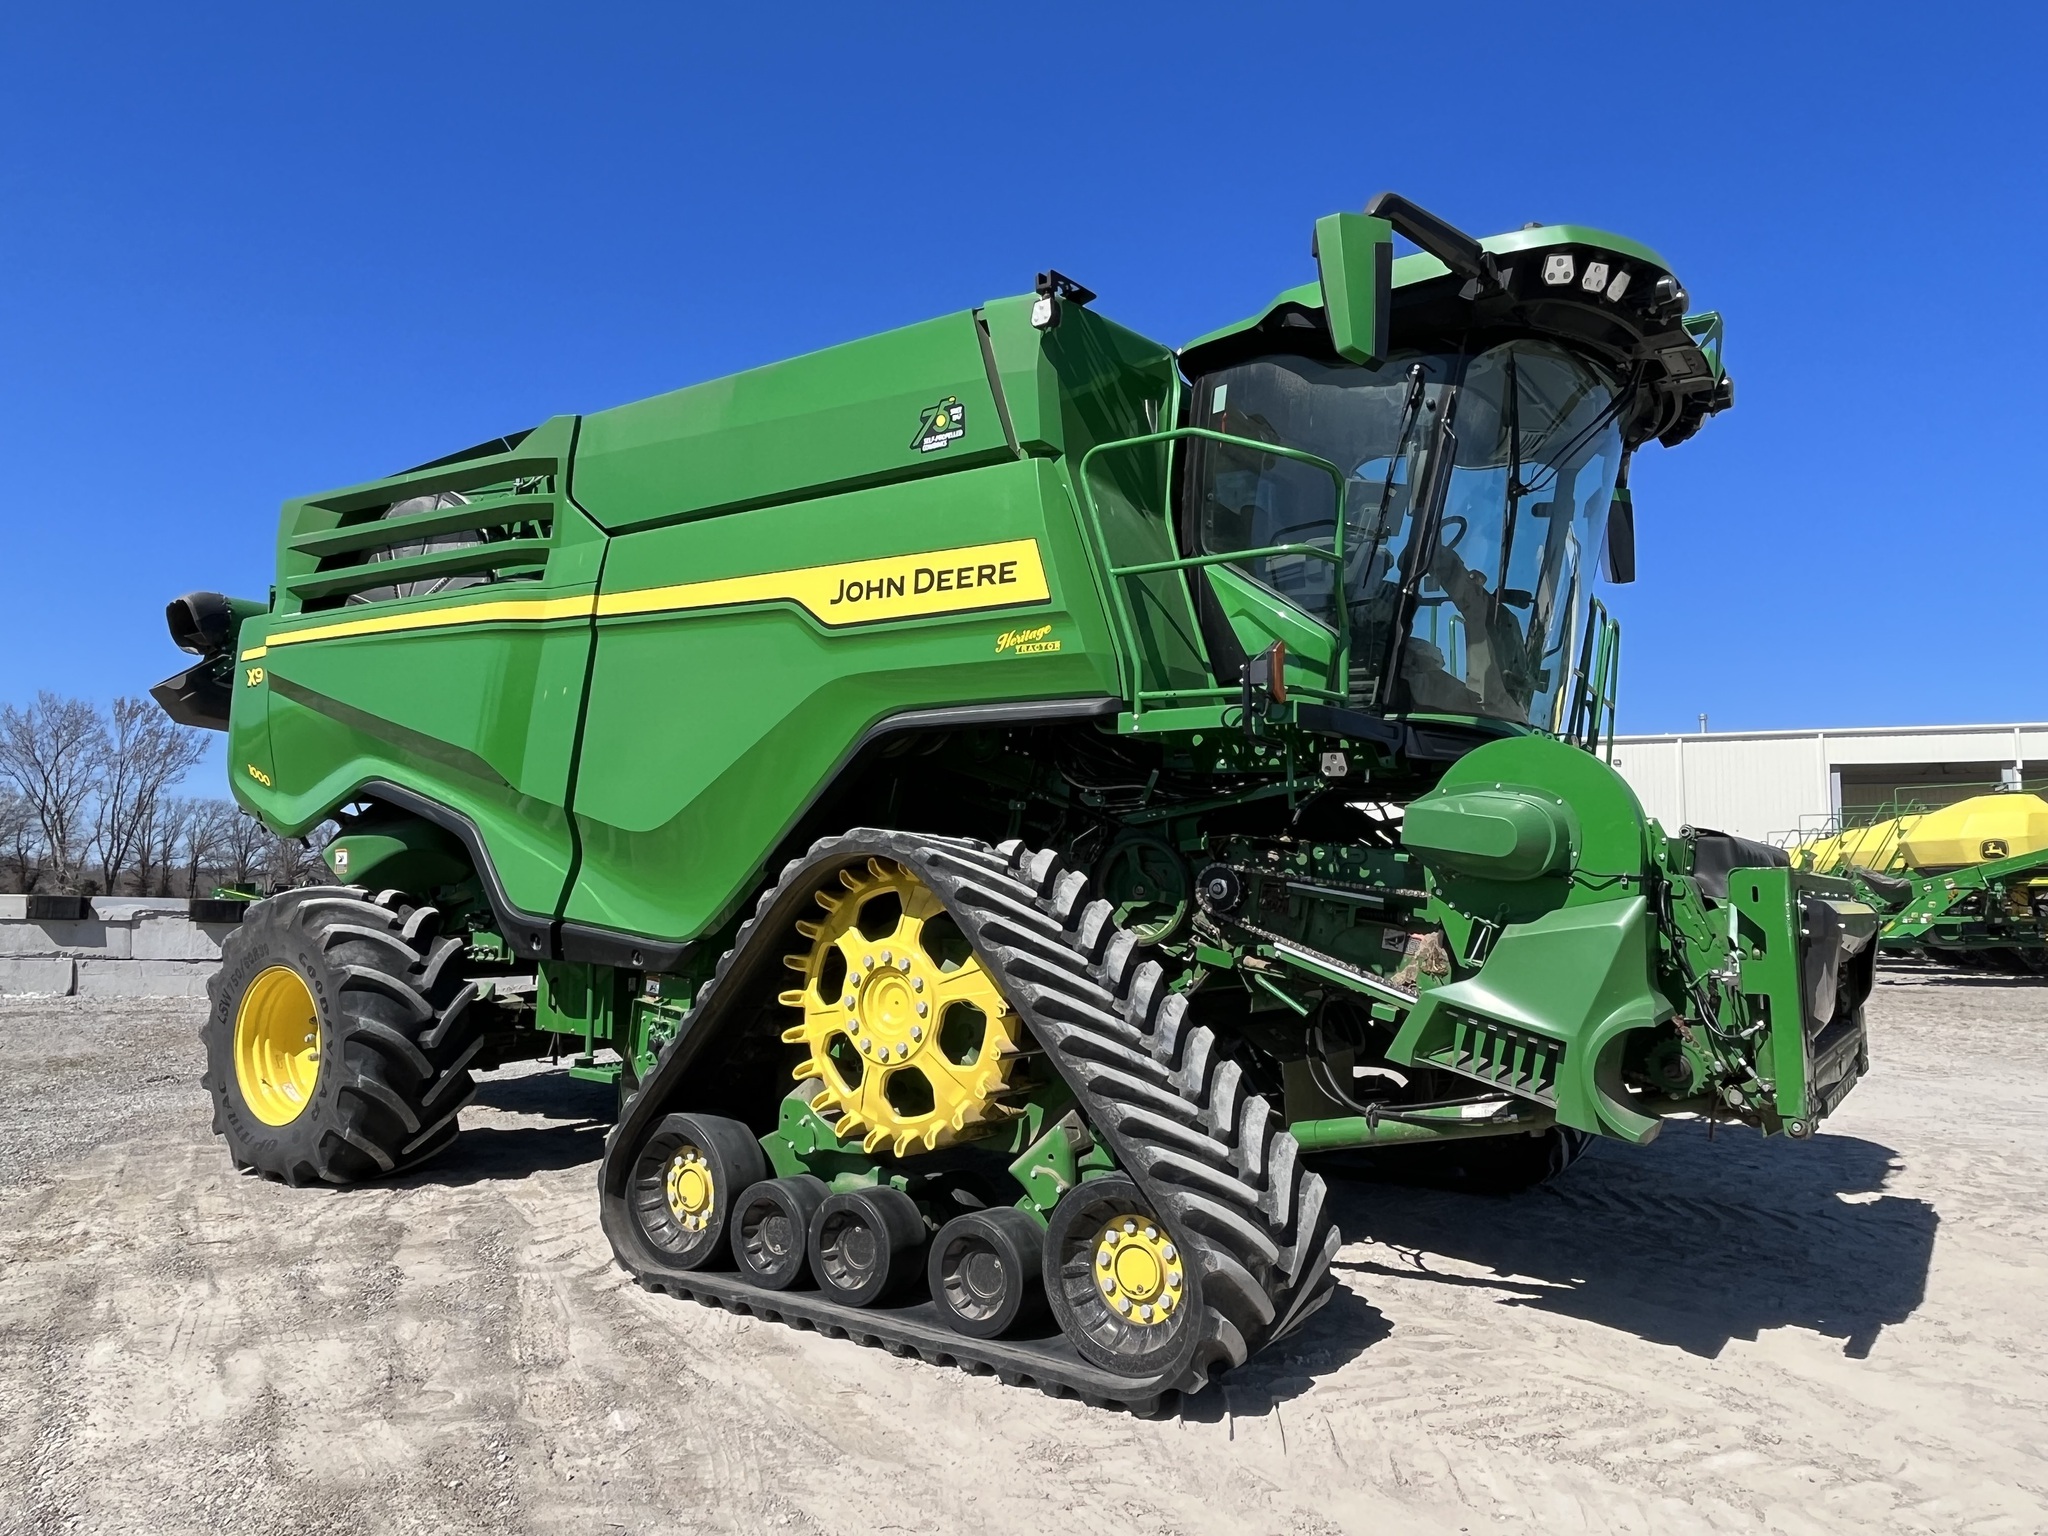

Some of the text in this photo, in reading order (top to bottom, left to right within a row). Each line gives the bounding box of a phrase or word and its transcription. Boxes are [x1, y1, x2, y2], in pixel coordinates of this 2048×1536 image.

[830, 561, 1018, 605] JOHN DEERE
[995, 625, 1052, 654] Heritage
[1015, 641, 1061, 655] TRACTOR
[246, 667, 264, 687] X9
[247, 763, 271, 787] 1000
